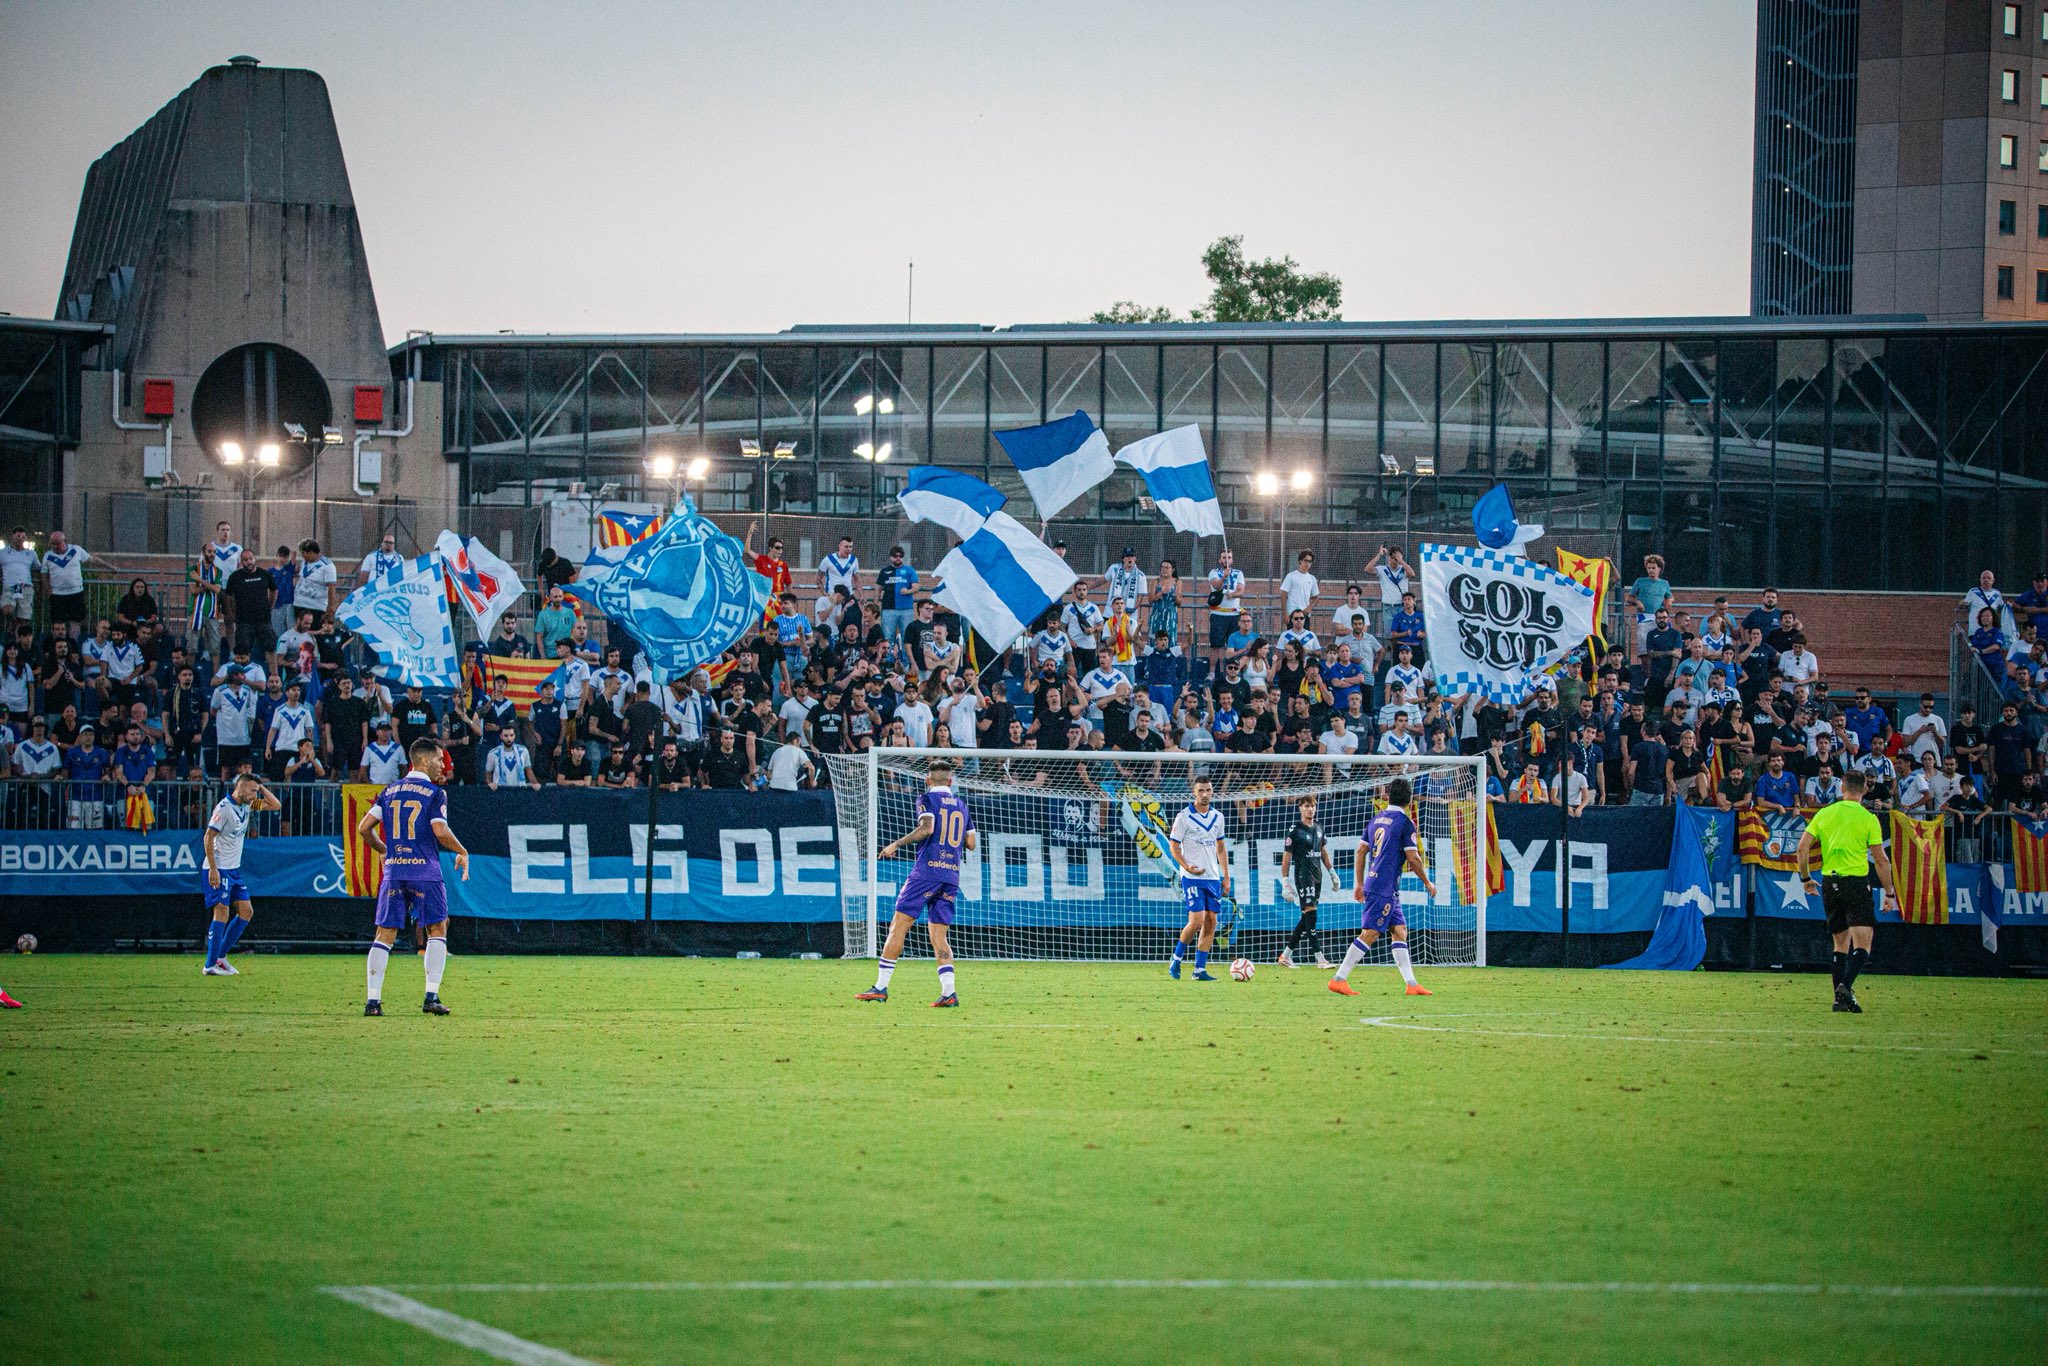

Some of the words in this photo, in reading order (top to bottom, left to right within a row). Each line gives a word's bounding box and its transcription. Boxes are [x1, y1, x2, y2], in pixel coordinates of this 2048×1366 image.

[1446, 574, 1563, 633] GOL
[1457, 619, 1558, 672] SUD
[389, 799, 423, 840] 17
[939, 807, 964, 848] 10
[1, 844, 197, 870] BOIXADERA
[508, 824, 690, 894] ELS
[719, 826, 897, 897] DEL
[1373, 827, 1386, 858] 9
[1187, 886, 1199, 900] 14
[1305, 886, 1316, 897] 13
[1382, 903, 1392, 917] 9
